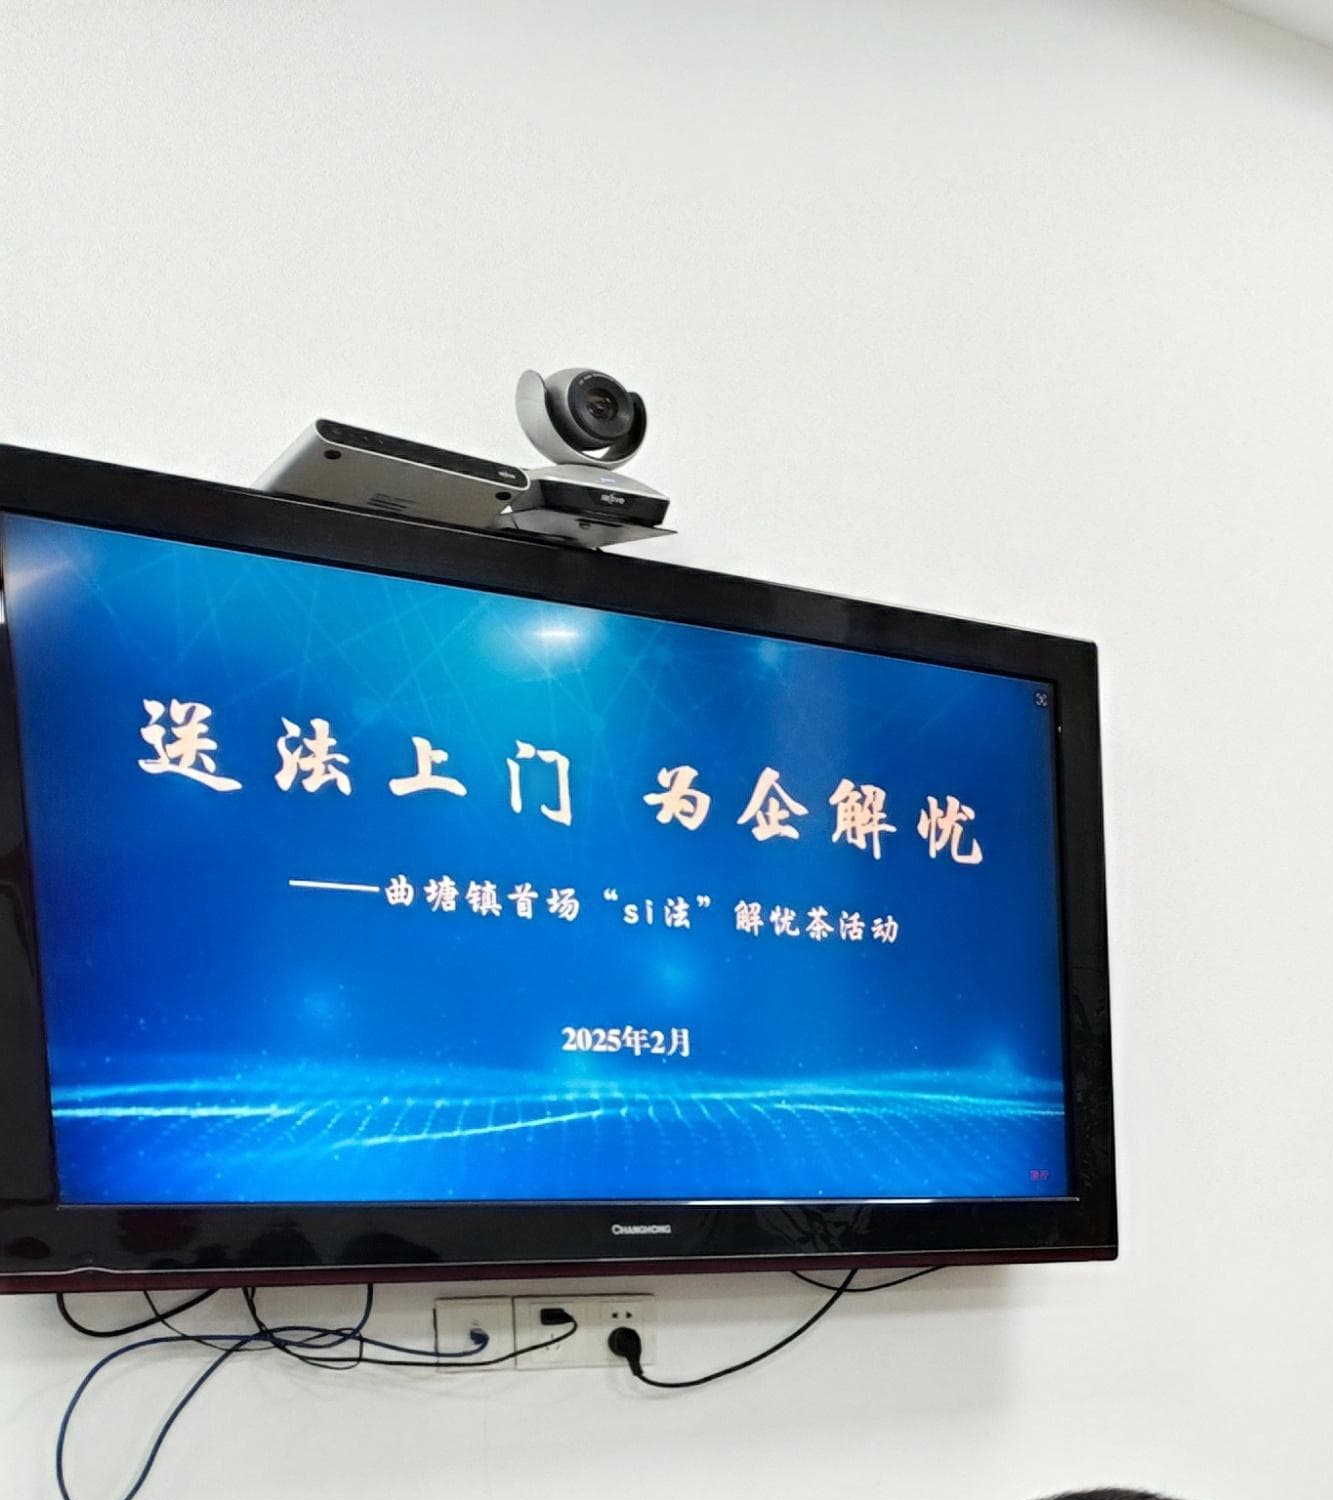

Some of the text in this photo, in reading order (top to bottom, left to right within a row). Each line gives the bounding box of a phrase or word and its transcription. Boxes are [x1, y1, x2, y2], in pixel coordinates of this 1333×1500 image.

[138, 698, 985, 866] 送法上门 为企解忧
[561, 1025, 690, 1057] 2025年2月
